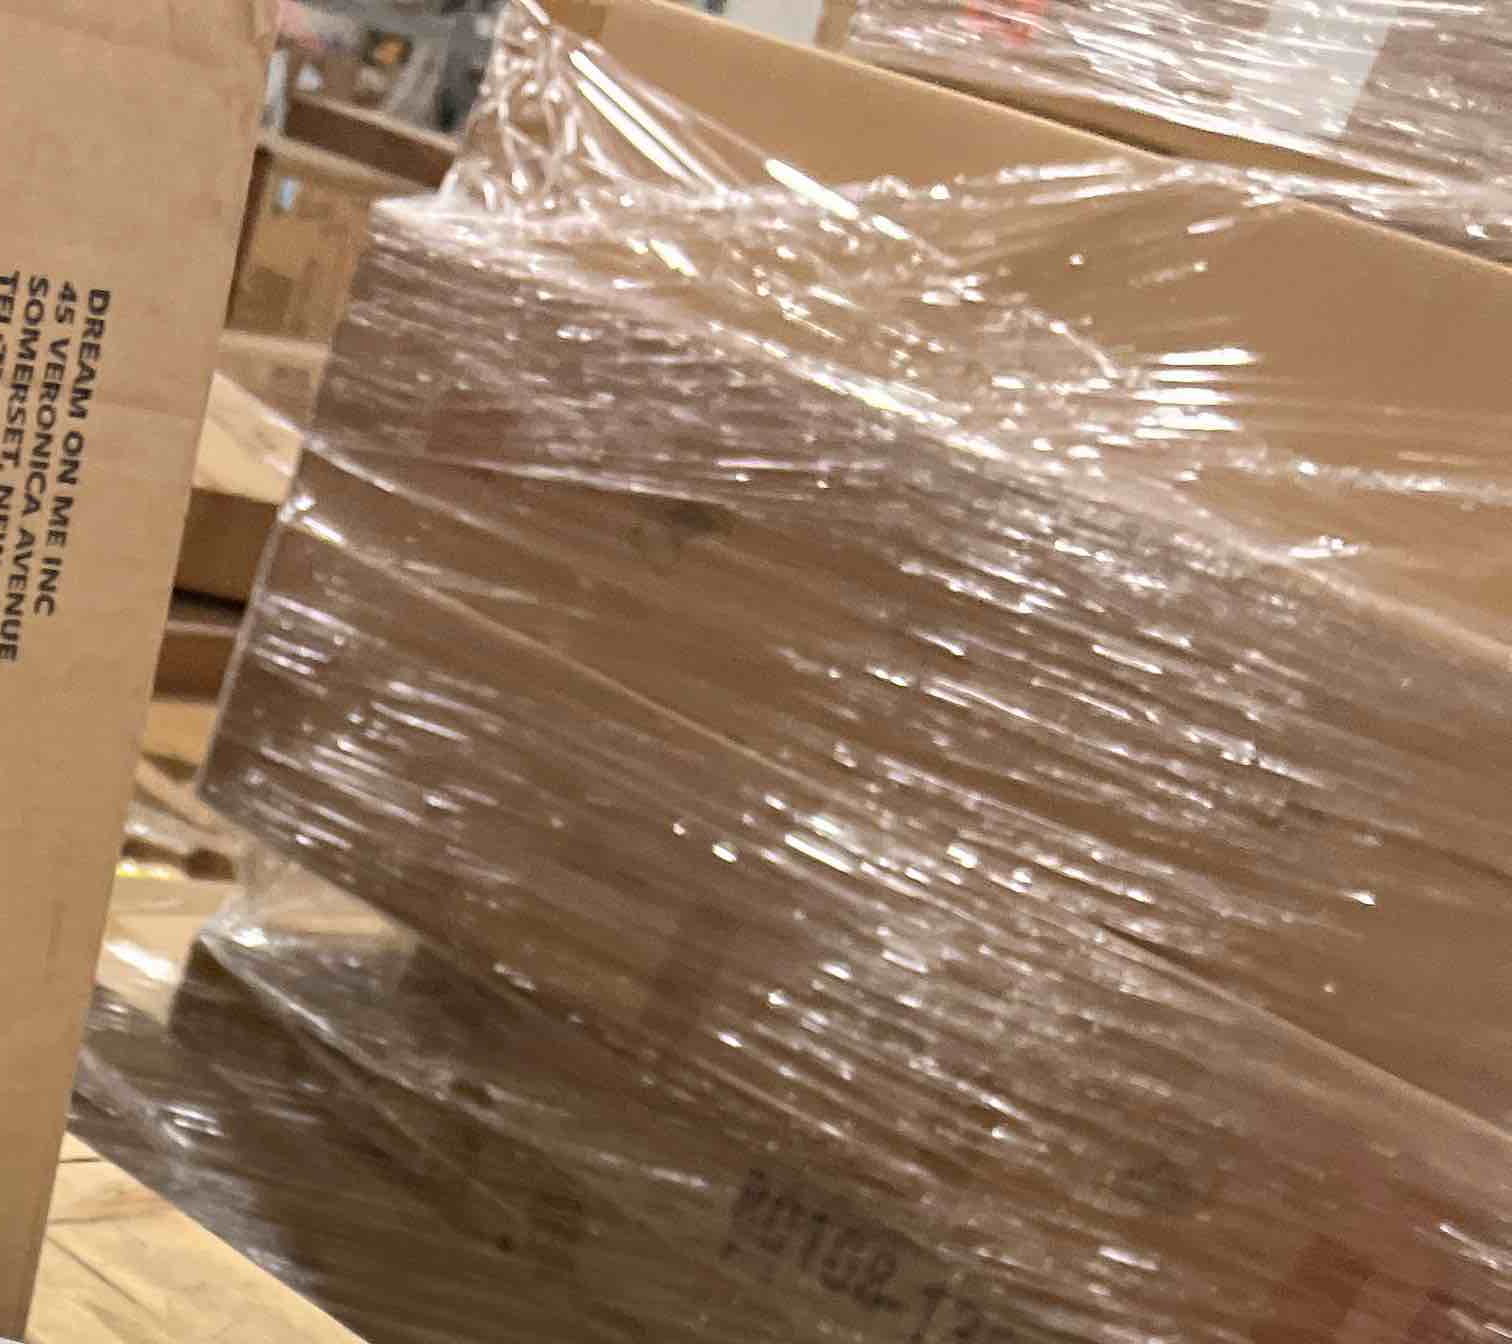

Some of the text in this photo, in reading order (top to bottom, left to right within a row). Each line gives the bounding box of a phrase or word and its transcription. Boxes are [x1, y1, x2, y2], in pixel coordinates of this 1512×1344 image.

[54, 280, 78, 324] 45
[21, 337, 71, 517] VERONICA
[33, 288, 112, 617] DREAM ON ME INC
